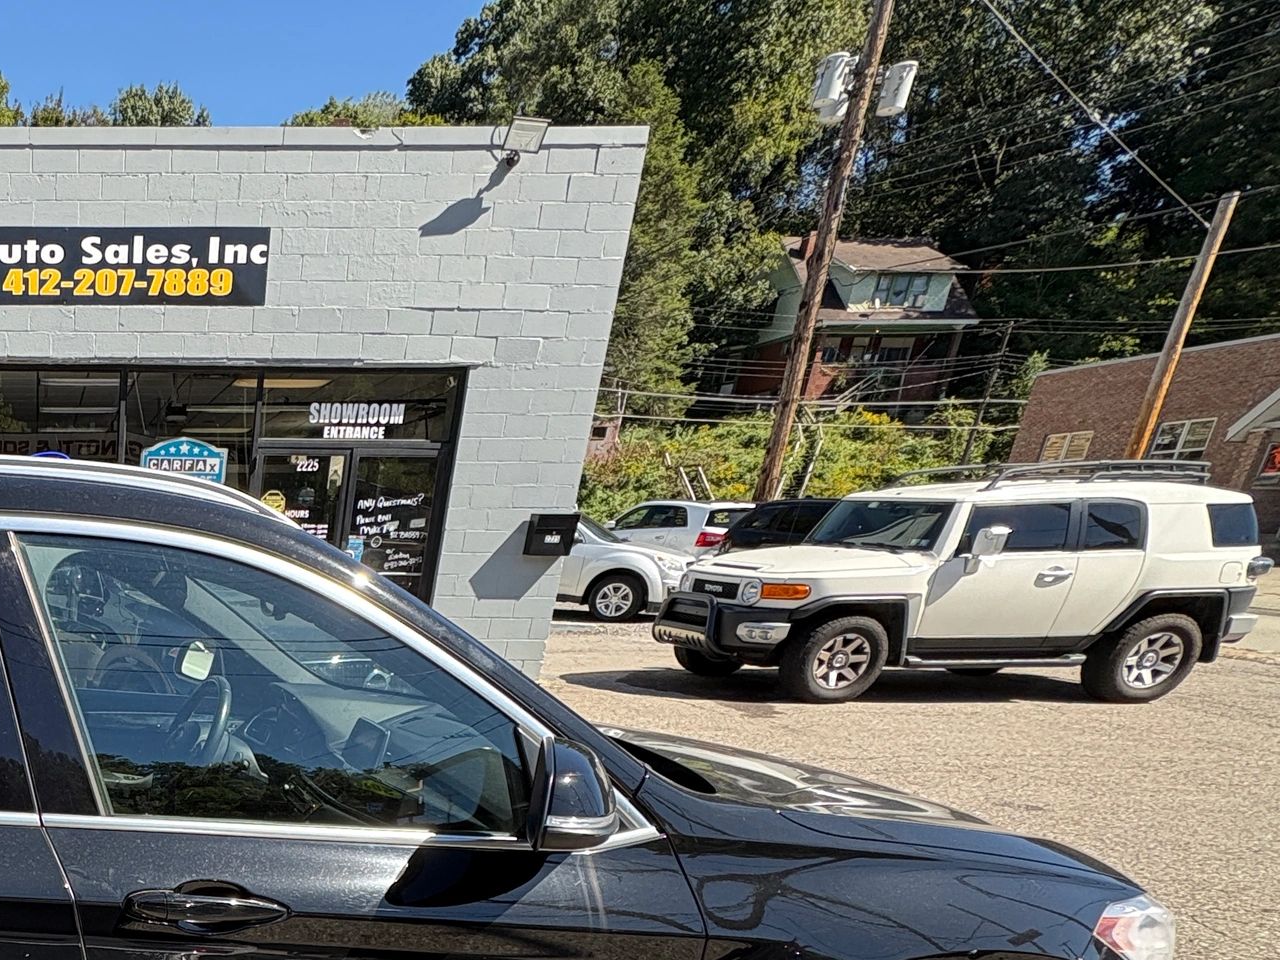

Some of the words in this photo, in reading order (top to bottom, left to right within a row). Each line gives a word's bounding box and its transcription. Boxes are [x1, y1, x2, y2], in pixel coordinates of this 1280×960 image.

[208, 236, 268, 265] Inc
[2, 268, 234, 297] 412-207-7889
[308, 402, 406, 425] SHOWROOM
[322, 426, 386, 439] ENTRANCE
[149, 458, 217, 473] CARFAX
[296, 458, 320, 472] 2225
[357, 498, 376, 512] ANY
[285, 509, 310, 519] HOURS
